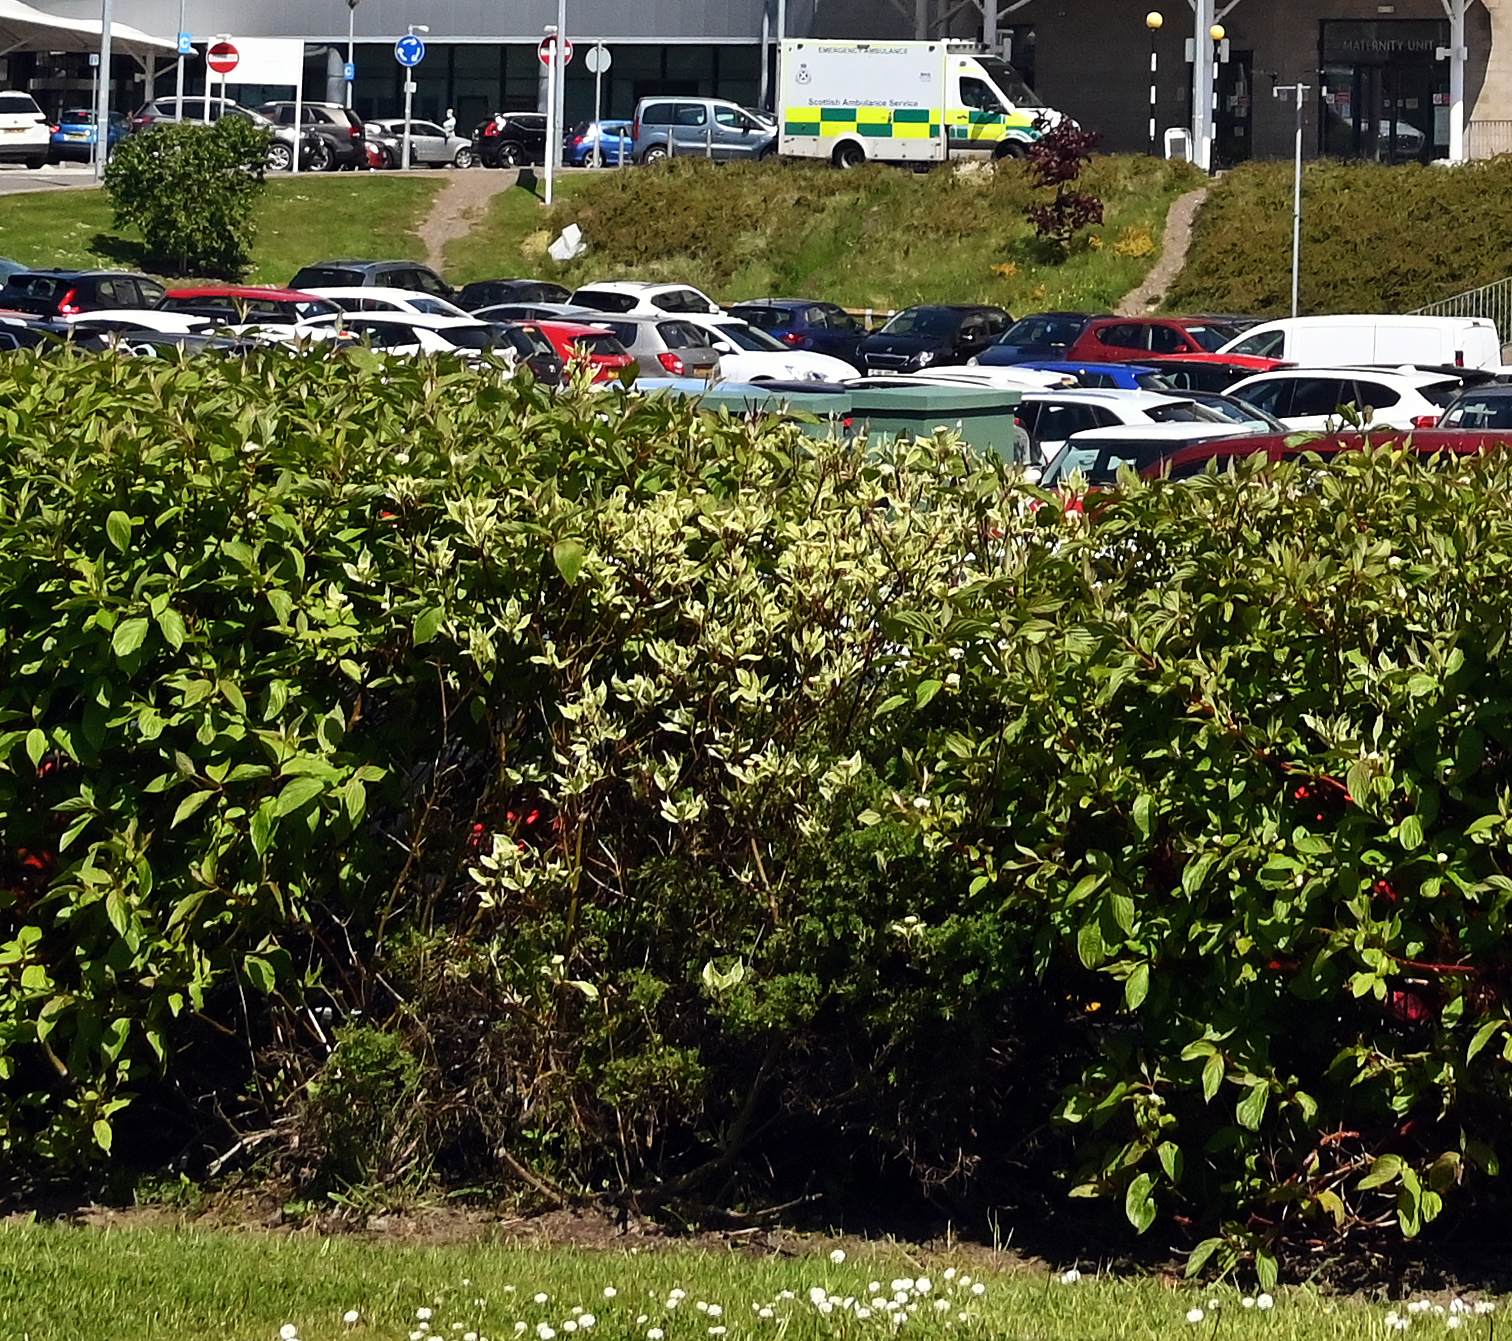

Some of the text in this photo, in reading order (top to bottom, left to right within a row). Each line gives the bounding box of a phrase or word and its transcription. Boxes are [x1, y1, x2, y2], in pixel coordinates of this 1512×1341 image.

[179, 37, 188, 48] C
[1342, 39, 1434, 51] MATERNITY UNIT
[864, 47, 908, 55] AMBULANCE
[345, 67, 352, 75] C
[808, 97, 919, 107] Scottish Ambulance Service
